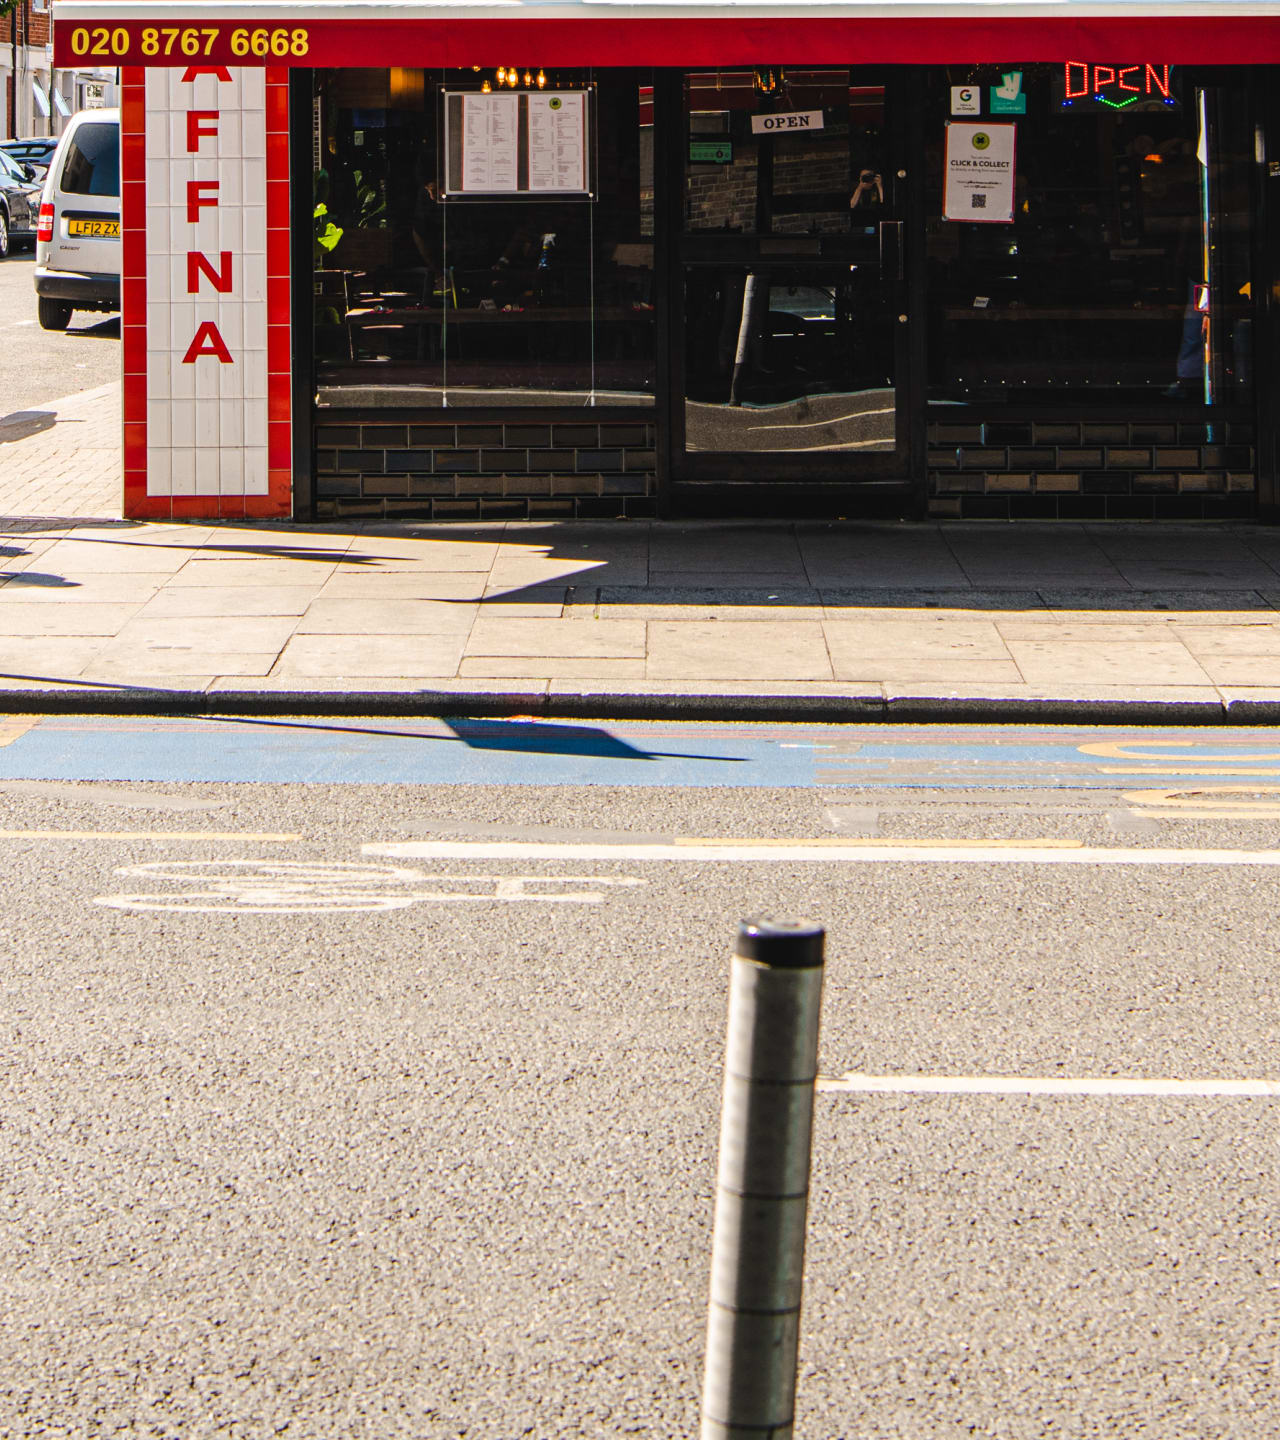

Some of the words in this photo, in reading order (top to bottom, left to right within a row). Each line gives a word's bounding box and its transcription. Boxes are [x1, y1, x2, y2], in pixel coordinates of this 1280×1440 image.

[70, 26, 131, 56] 020
[140, 26, 220, 56] 8767
[230, 26, 310, 56] 6668
[763, 115, 811, 130] OPEN
[76, 222, 102, 234] LF12
[104, 223, 120, 234] ZX
